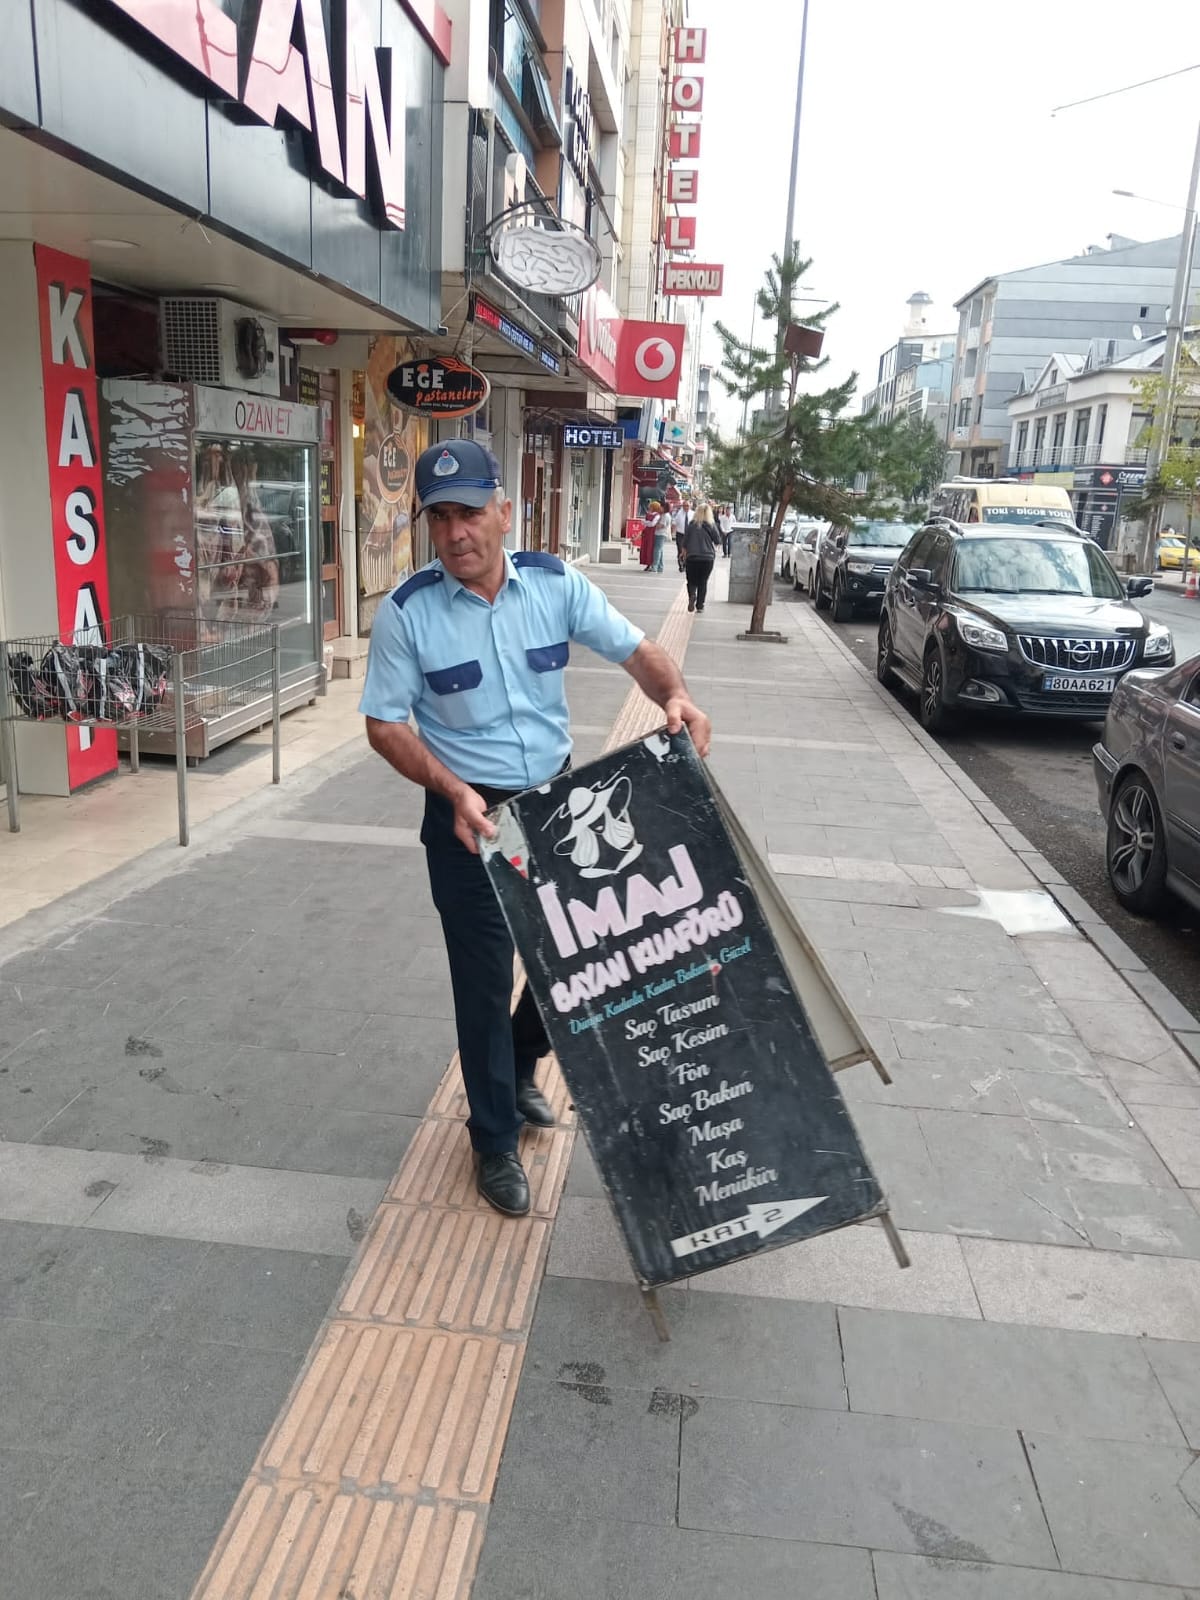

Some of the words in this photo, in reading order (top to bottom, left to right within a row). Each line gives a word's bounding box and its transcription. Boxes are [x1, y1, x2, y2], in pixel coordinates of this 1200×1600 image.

[670, 28, 703, 246] HOTEL
[402, 367, 444, 389] EGE
[416, 386, 484, 406] pastaneleri
[235, 400, 273, 433] OZAN
[277, 407, 292, 434] ET
[565, 428, 622, 446] HOTEL
[383, 445, 396, 467] EGE
[47, 284, 105, 752] KASA
[1052, 678, 1113, 691] 80AA621
[550, 950, 631, 1013] BAYAN
[624, 1019, 658, 1040] Saç
[638, 1046, 671, 1068] Saç
[671, 1023, 730, 1053] Kesim
[674, 1062, 711, 1085] Fön
[658, 1103, 692, 1125] Saç
[691, 1080, 755, 1112] Bakım
[687, 1117, 745, 1146] Maşa
[706, 1147, 748, 1173] Kaş
[690, 1216, 750, 1248] KAT
[763, 1208, 785, 1223] 2
